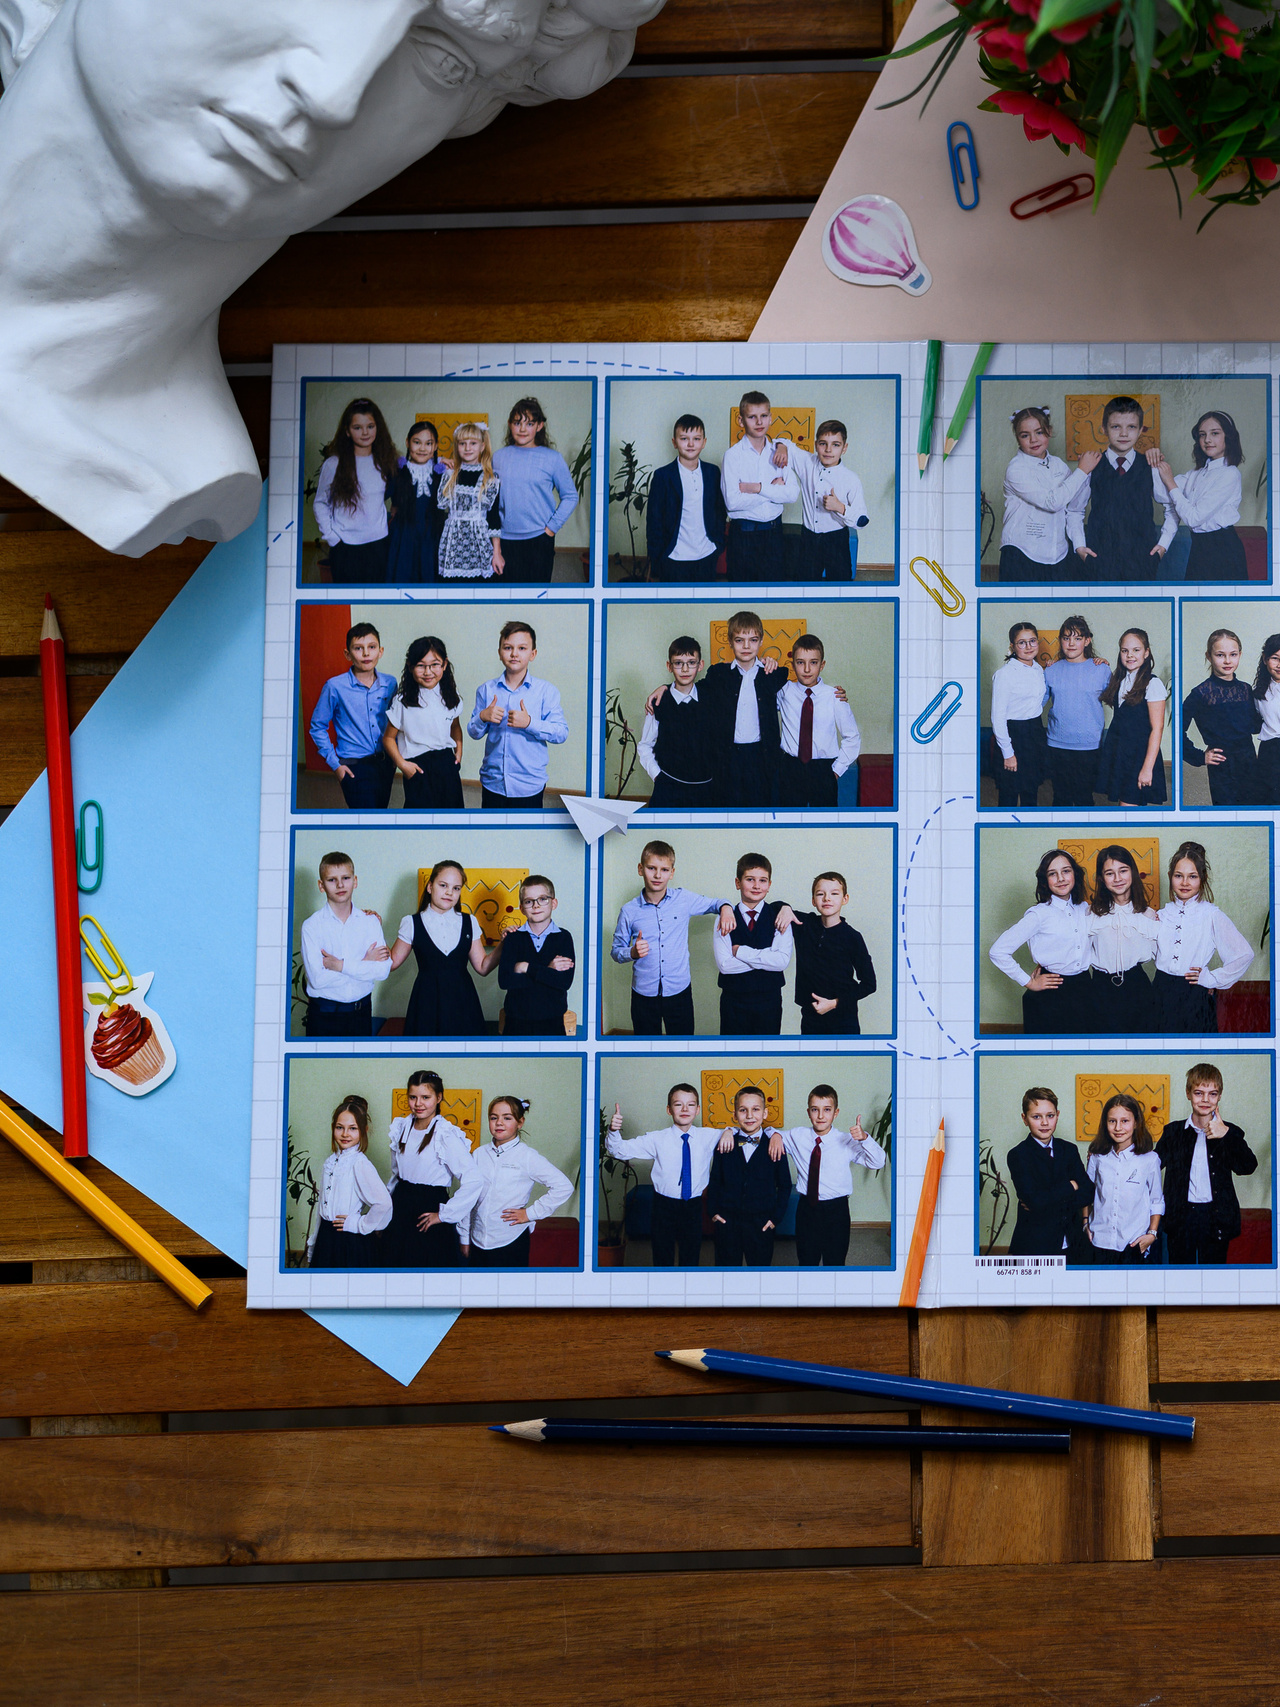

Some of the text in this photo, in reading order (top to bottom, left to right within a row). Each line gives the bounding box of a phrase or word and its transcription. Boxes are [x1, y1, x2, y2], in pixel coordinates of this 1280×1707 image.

[996, 1268, 1041, 1276] 667471 858 #1
